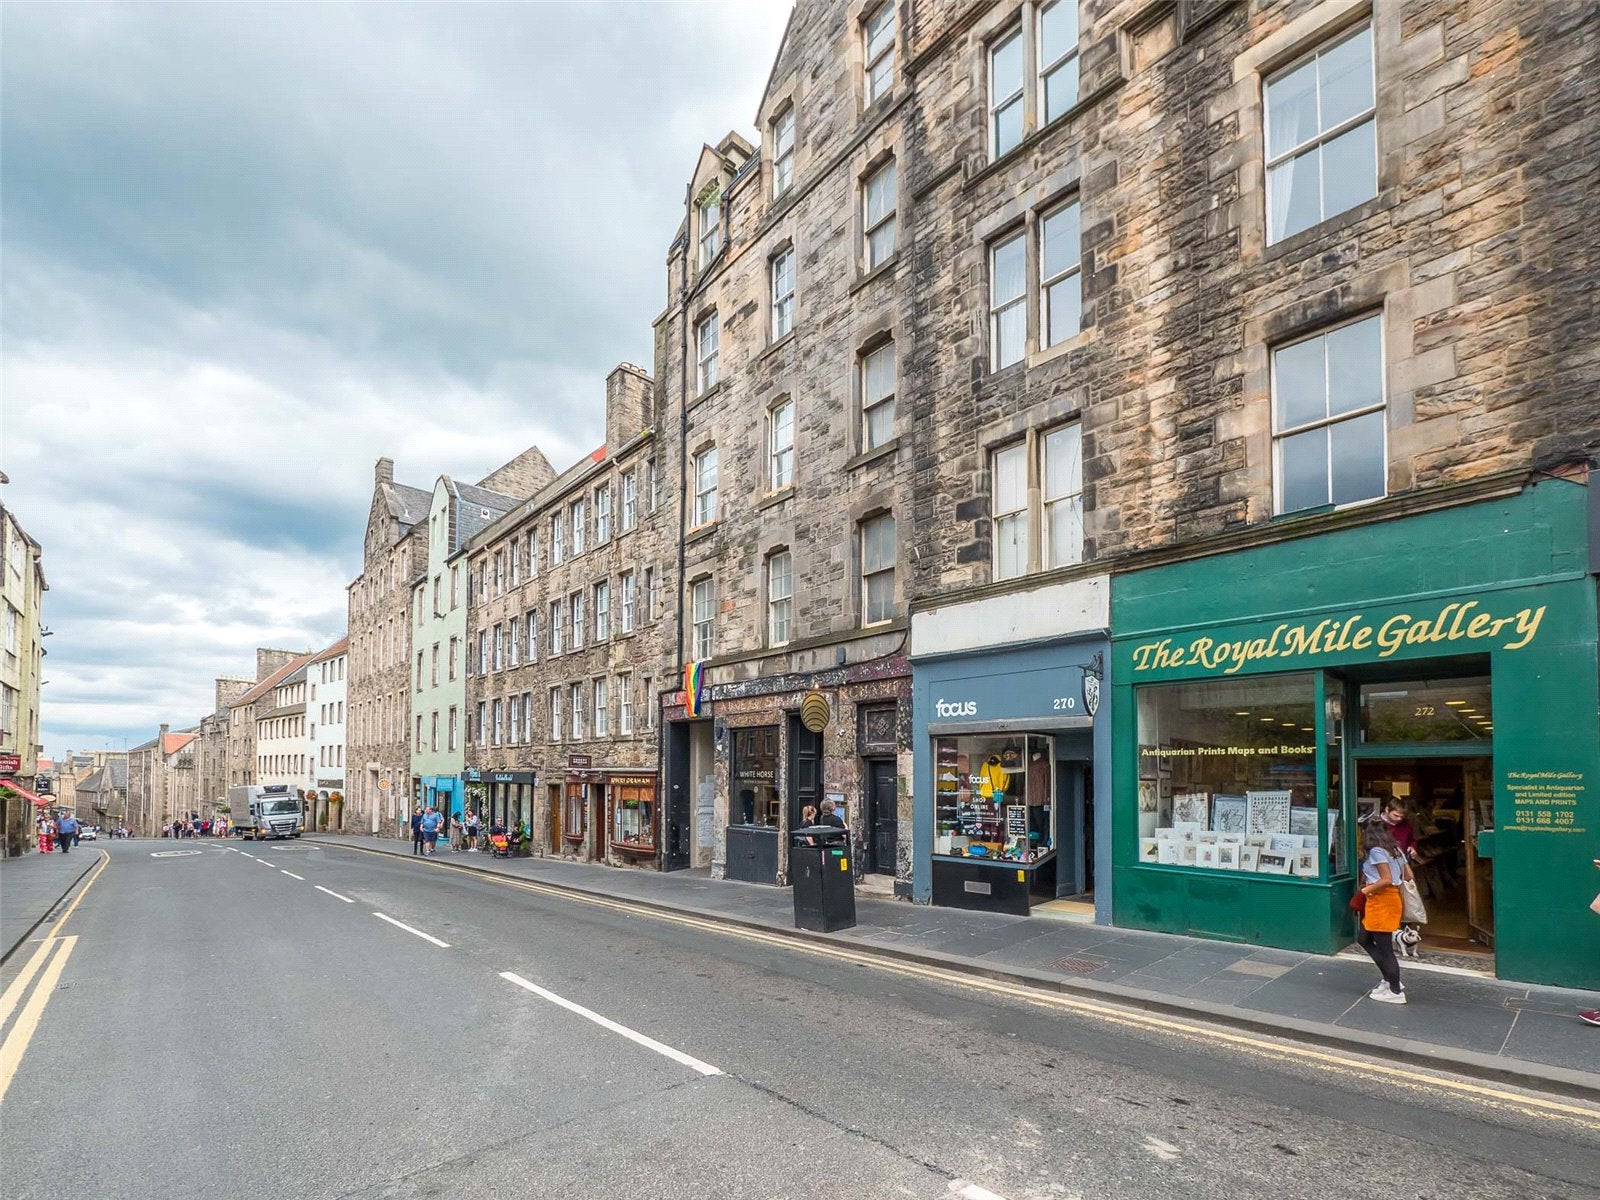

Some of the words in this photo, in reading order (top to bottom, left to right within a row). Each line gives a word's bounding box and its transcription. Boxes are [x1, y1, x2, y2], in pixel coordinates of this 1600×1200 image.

[1132, 638, 1185, 671] The
[1185, 624, 1288, 674] Royal
[1280, 615, 1373, 657] Mile
[1377, 601, 1547, 657] Gallery
[936, 698, 977, 718] focus
[1053, 698, 1075, 710] 270
[1415, 707, 1434, 716] 272
[1141, 748, 1195, 757] Antiquarian
[1198, 747, 1225, 755] Prints
[1228, 747, 1255, 756] Maps
[1258, 746, 1278, 754] and
[1281, 745, 1313, 754] Books
[968, 774, 990, 784] focus
[1521, 772, 1539, 780] Royal
[1557, 772, 1583, 780] Gallery
